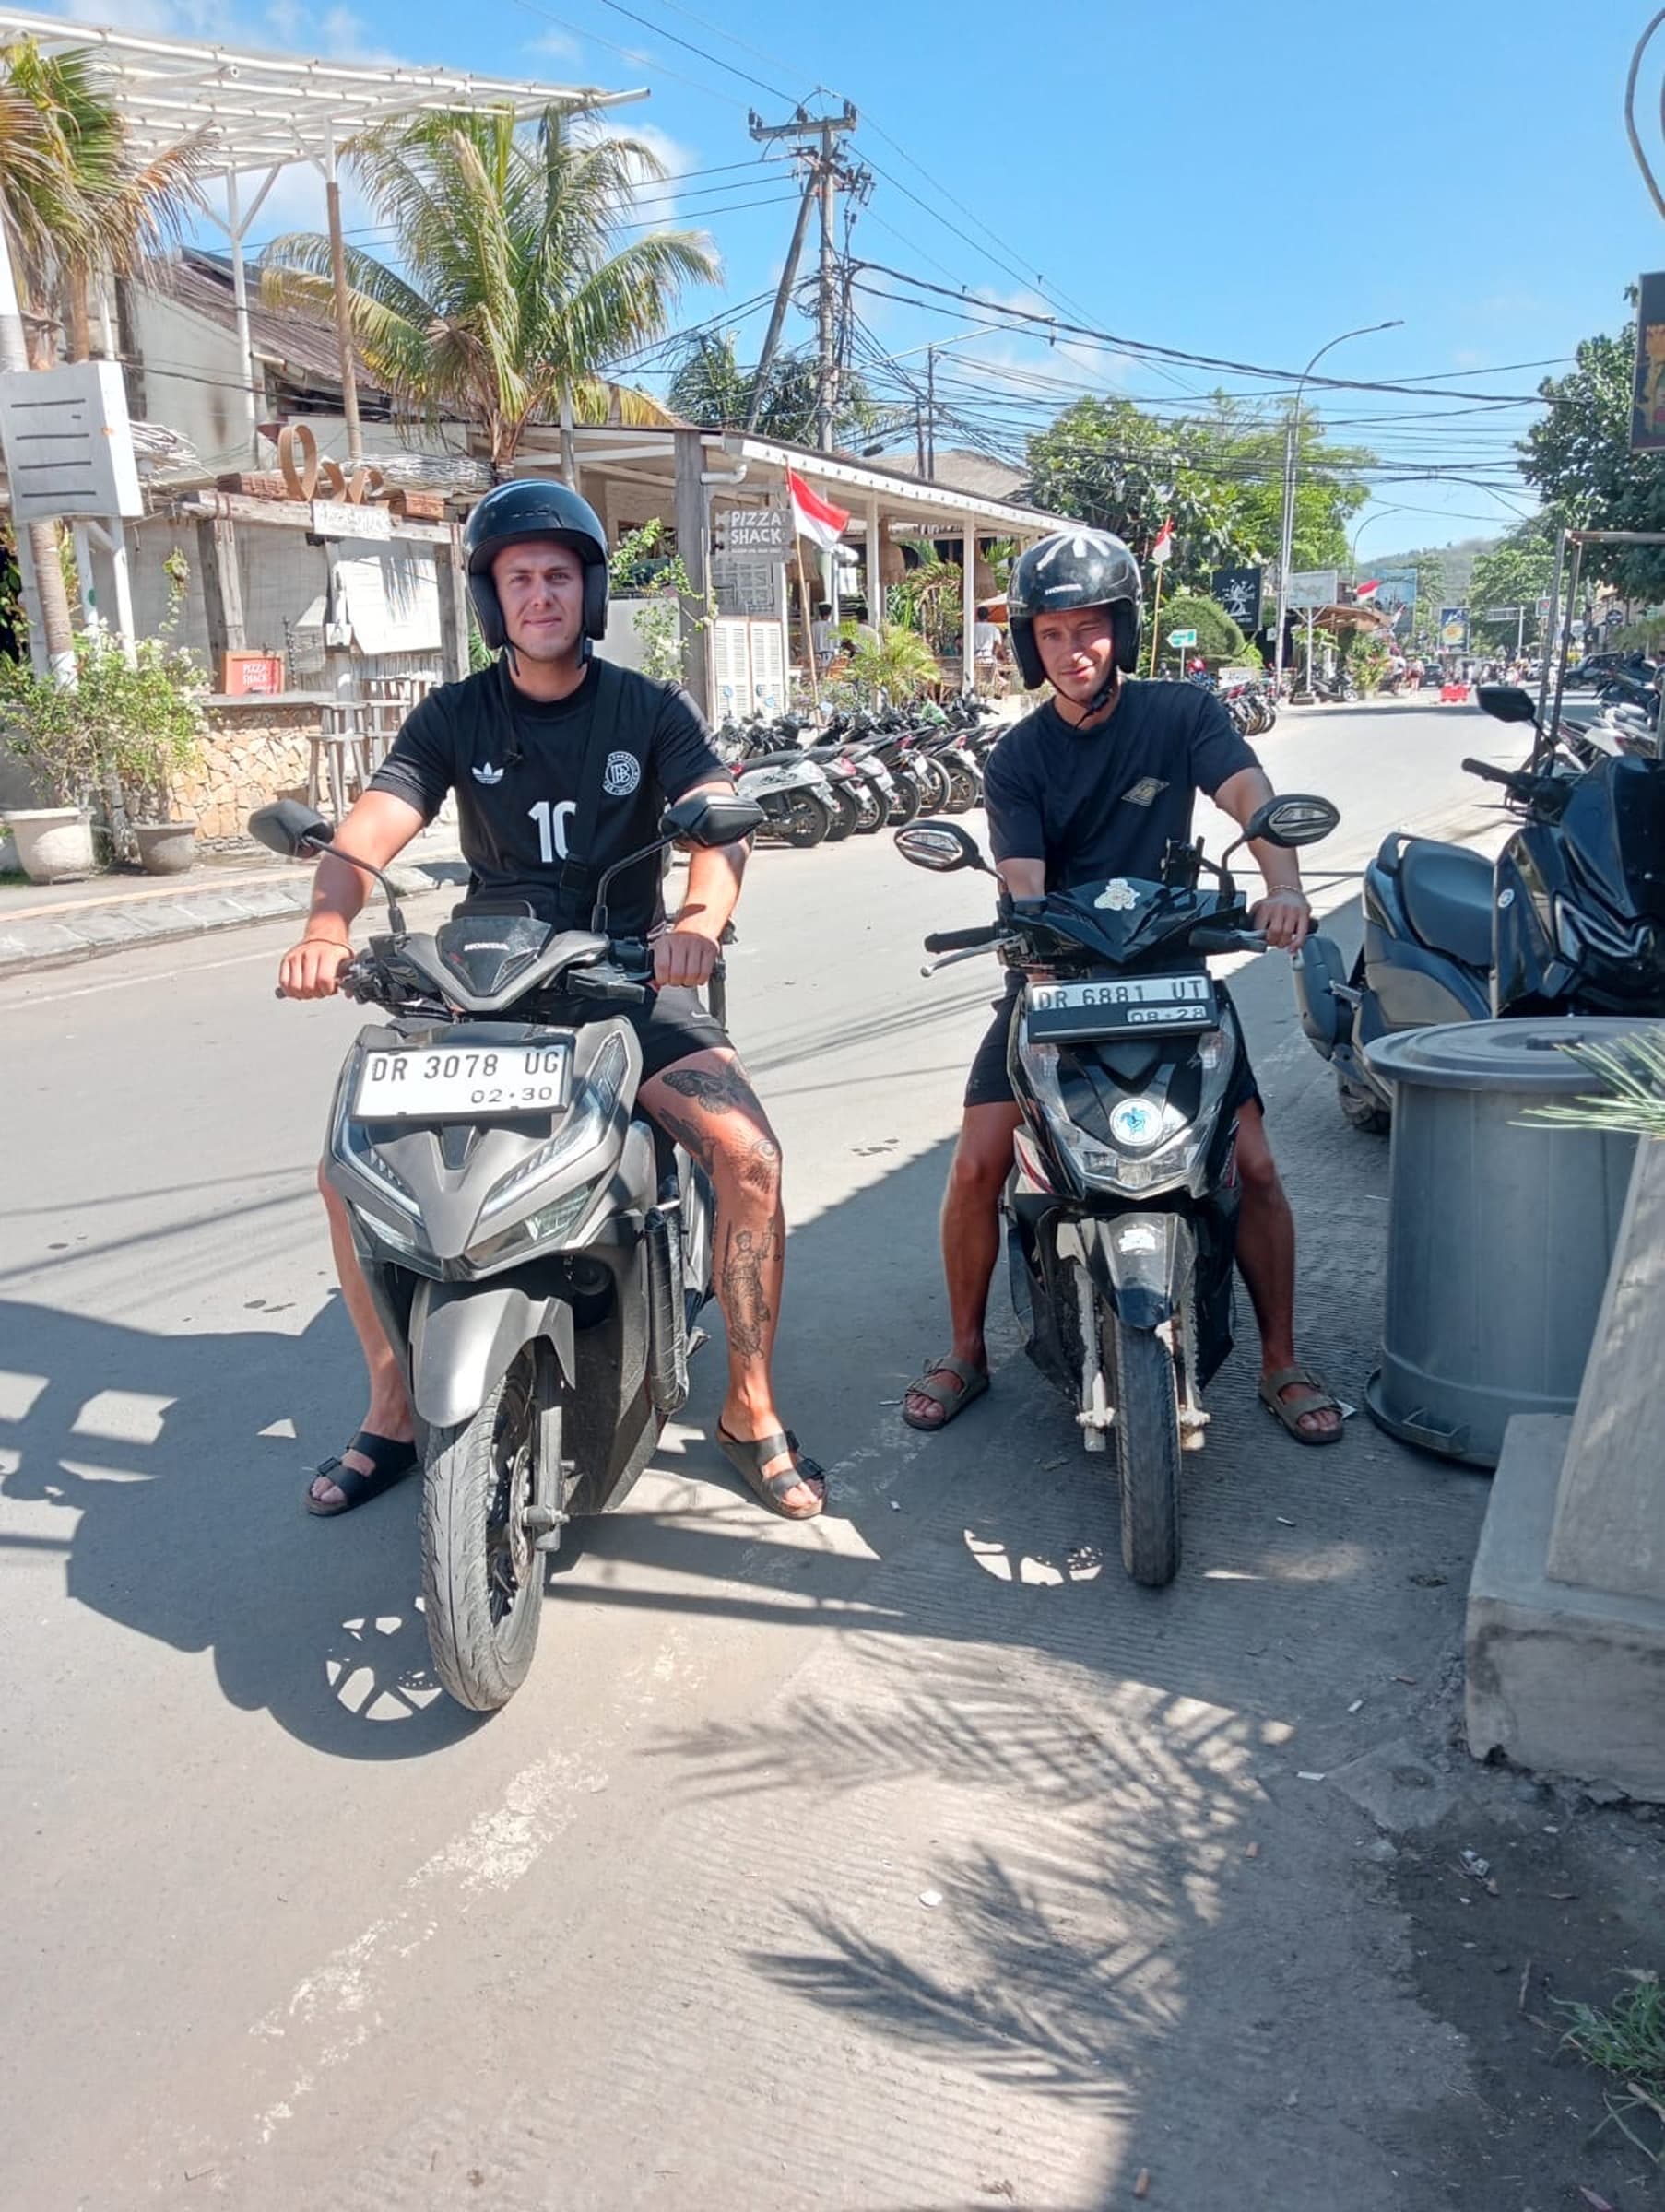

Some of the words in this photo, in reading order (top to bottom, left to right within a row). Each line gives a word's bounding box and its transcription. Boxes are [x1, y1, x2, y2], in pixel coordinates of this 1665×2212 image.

[731, 511, 782, 527] PIZZA
[731, 528, 782, 545] SHACK
[1036, 990, 1068, 1009] DR
[1082, 986, 1144, 1006] 6881
[1171, 980, 1202, 1000] UT
[372, 1057, 408, 1082] DR
[424, 1053, 499, 1079] 3078
[524, 1052, 560, 1076] UG
